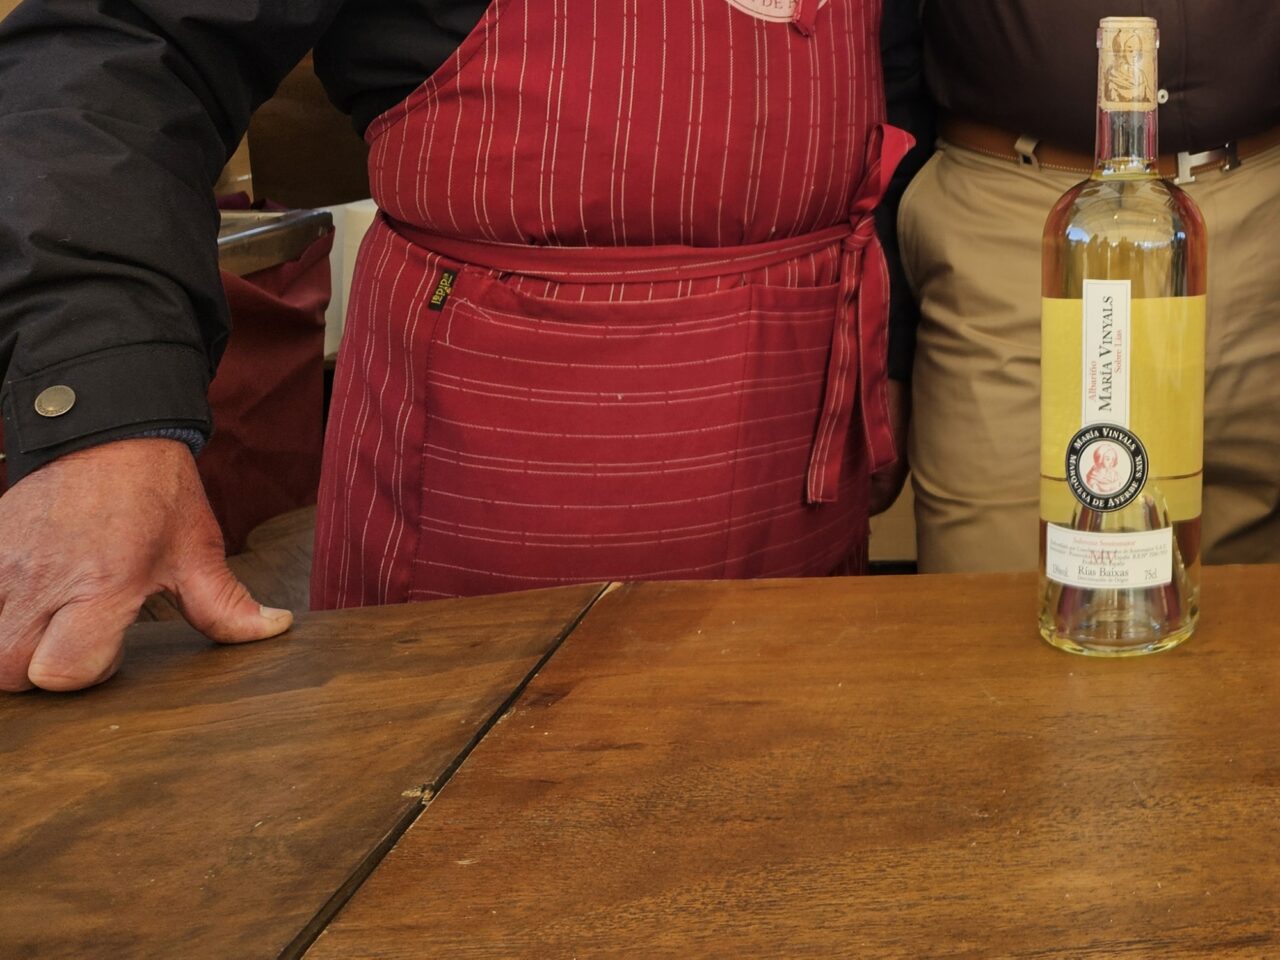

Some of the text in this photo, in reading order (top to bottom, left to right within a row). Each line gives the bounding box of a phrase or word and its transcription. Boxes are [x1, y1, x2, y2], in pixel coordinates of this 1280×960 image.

[1098, 295, 1113, 412] MARÍA VINYALS
[1114, 349, 1122, 374] Sobre
[1073, 427, 1137, 451] MARÍA VINYALS
[1069, 454, 1091, 503] MARQUESA
[1092, 498, 1105, 507] DE
[1107, 480, 1139, 507] AYERBE
[1099, 566, 1129, 577] Baixas
